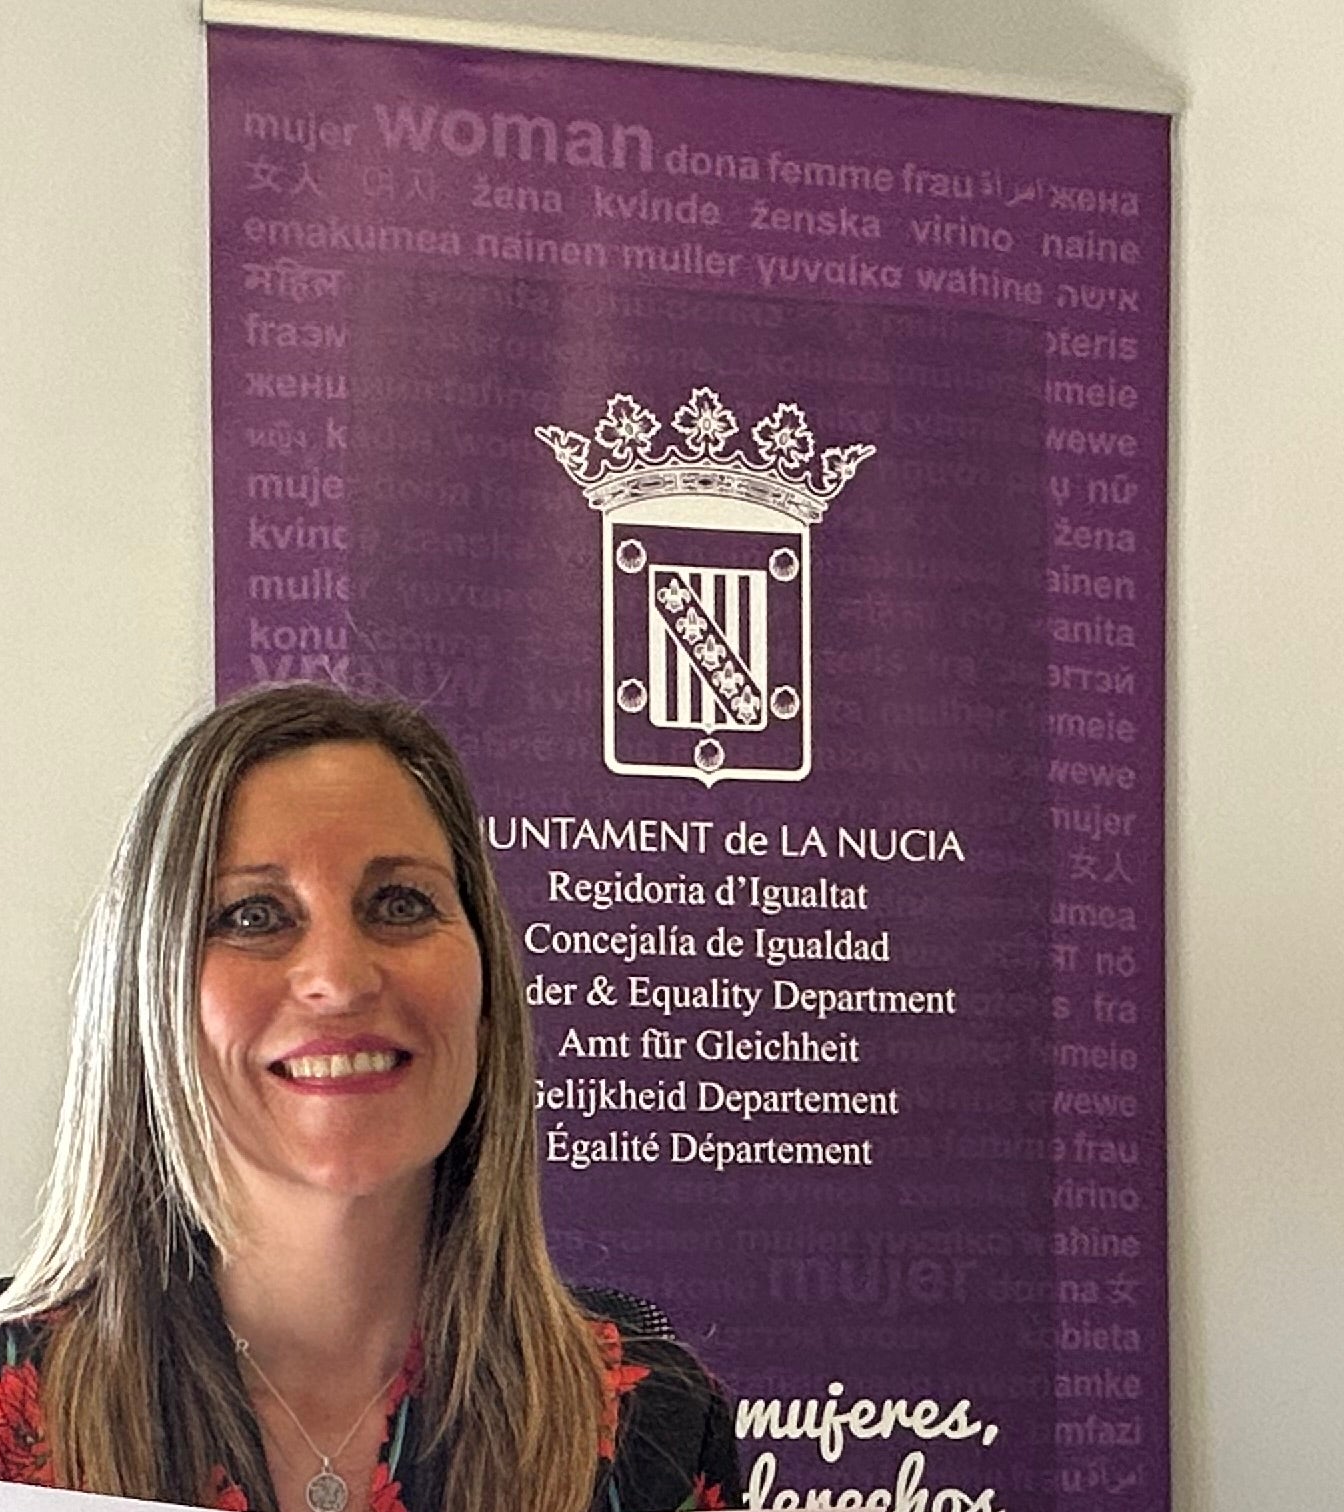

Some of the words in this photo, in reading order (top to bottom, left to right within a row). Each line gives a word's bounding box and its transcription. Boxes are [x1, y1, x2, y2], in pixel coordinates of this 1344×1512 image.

[244, 111, 357, 153] mujer
[374, 103, 654, 172] woman
[665, 144, 758, 180] dona
[770, 152, 894, 192] femme
[904, 162, 973, 199] frau
[245, 160, 322, 194] 女人
[472, 174, 563, 213] žena
[594, 185, 720, 225] kvinde
[751, 197, 881, 239] ženska
[911, 215, 1014, 252] virino
[1041, 228, 1141, 266] naine
[244, 217, 460, 256] emakumea
[477, 230, 606, 268] nainen
[622, 242, 739, 276] muller
[915, 264, 1042, 306] wahine
[1045, 377, 1139, 411] meie
[1049, 710, 1138, 745] meie
[482, 816, 713, 853] UNTAMENT
[725, 821, 768, 857] de
[781, 825, 826, 859] LA
[838, 827, 965, 862] NUCIA
[1069, 851, 1135, 887] 女人
[548, 871, 705, 911] Regidoria
[523, 923, 696, 963] Concejalía
[707, 928, 744, 959] de
[755, 928, 891, 966] Igualdad
[586, 976, 617, 1005] &
[629, 977, 762, 1018] Equality
[773, 980, 956, 1018] Department
[558, 1030, 630, 1060] Amt
[641, 1029, 687, 1060] für
[696, 1030, 859, 1064] Gleichheit
[698, 1082, 899, 1120] Departement
[546, 1122, 658, 1170] Égalité
[670, 1127, 873, 1171] Département
[735, 1382, 999, 1462] mujeres,
